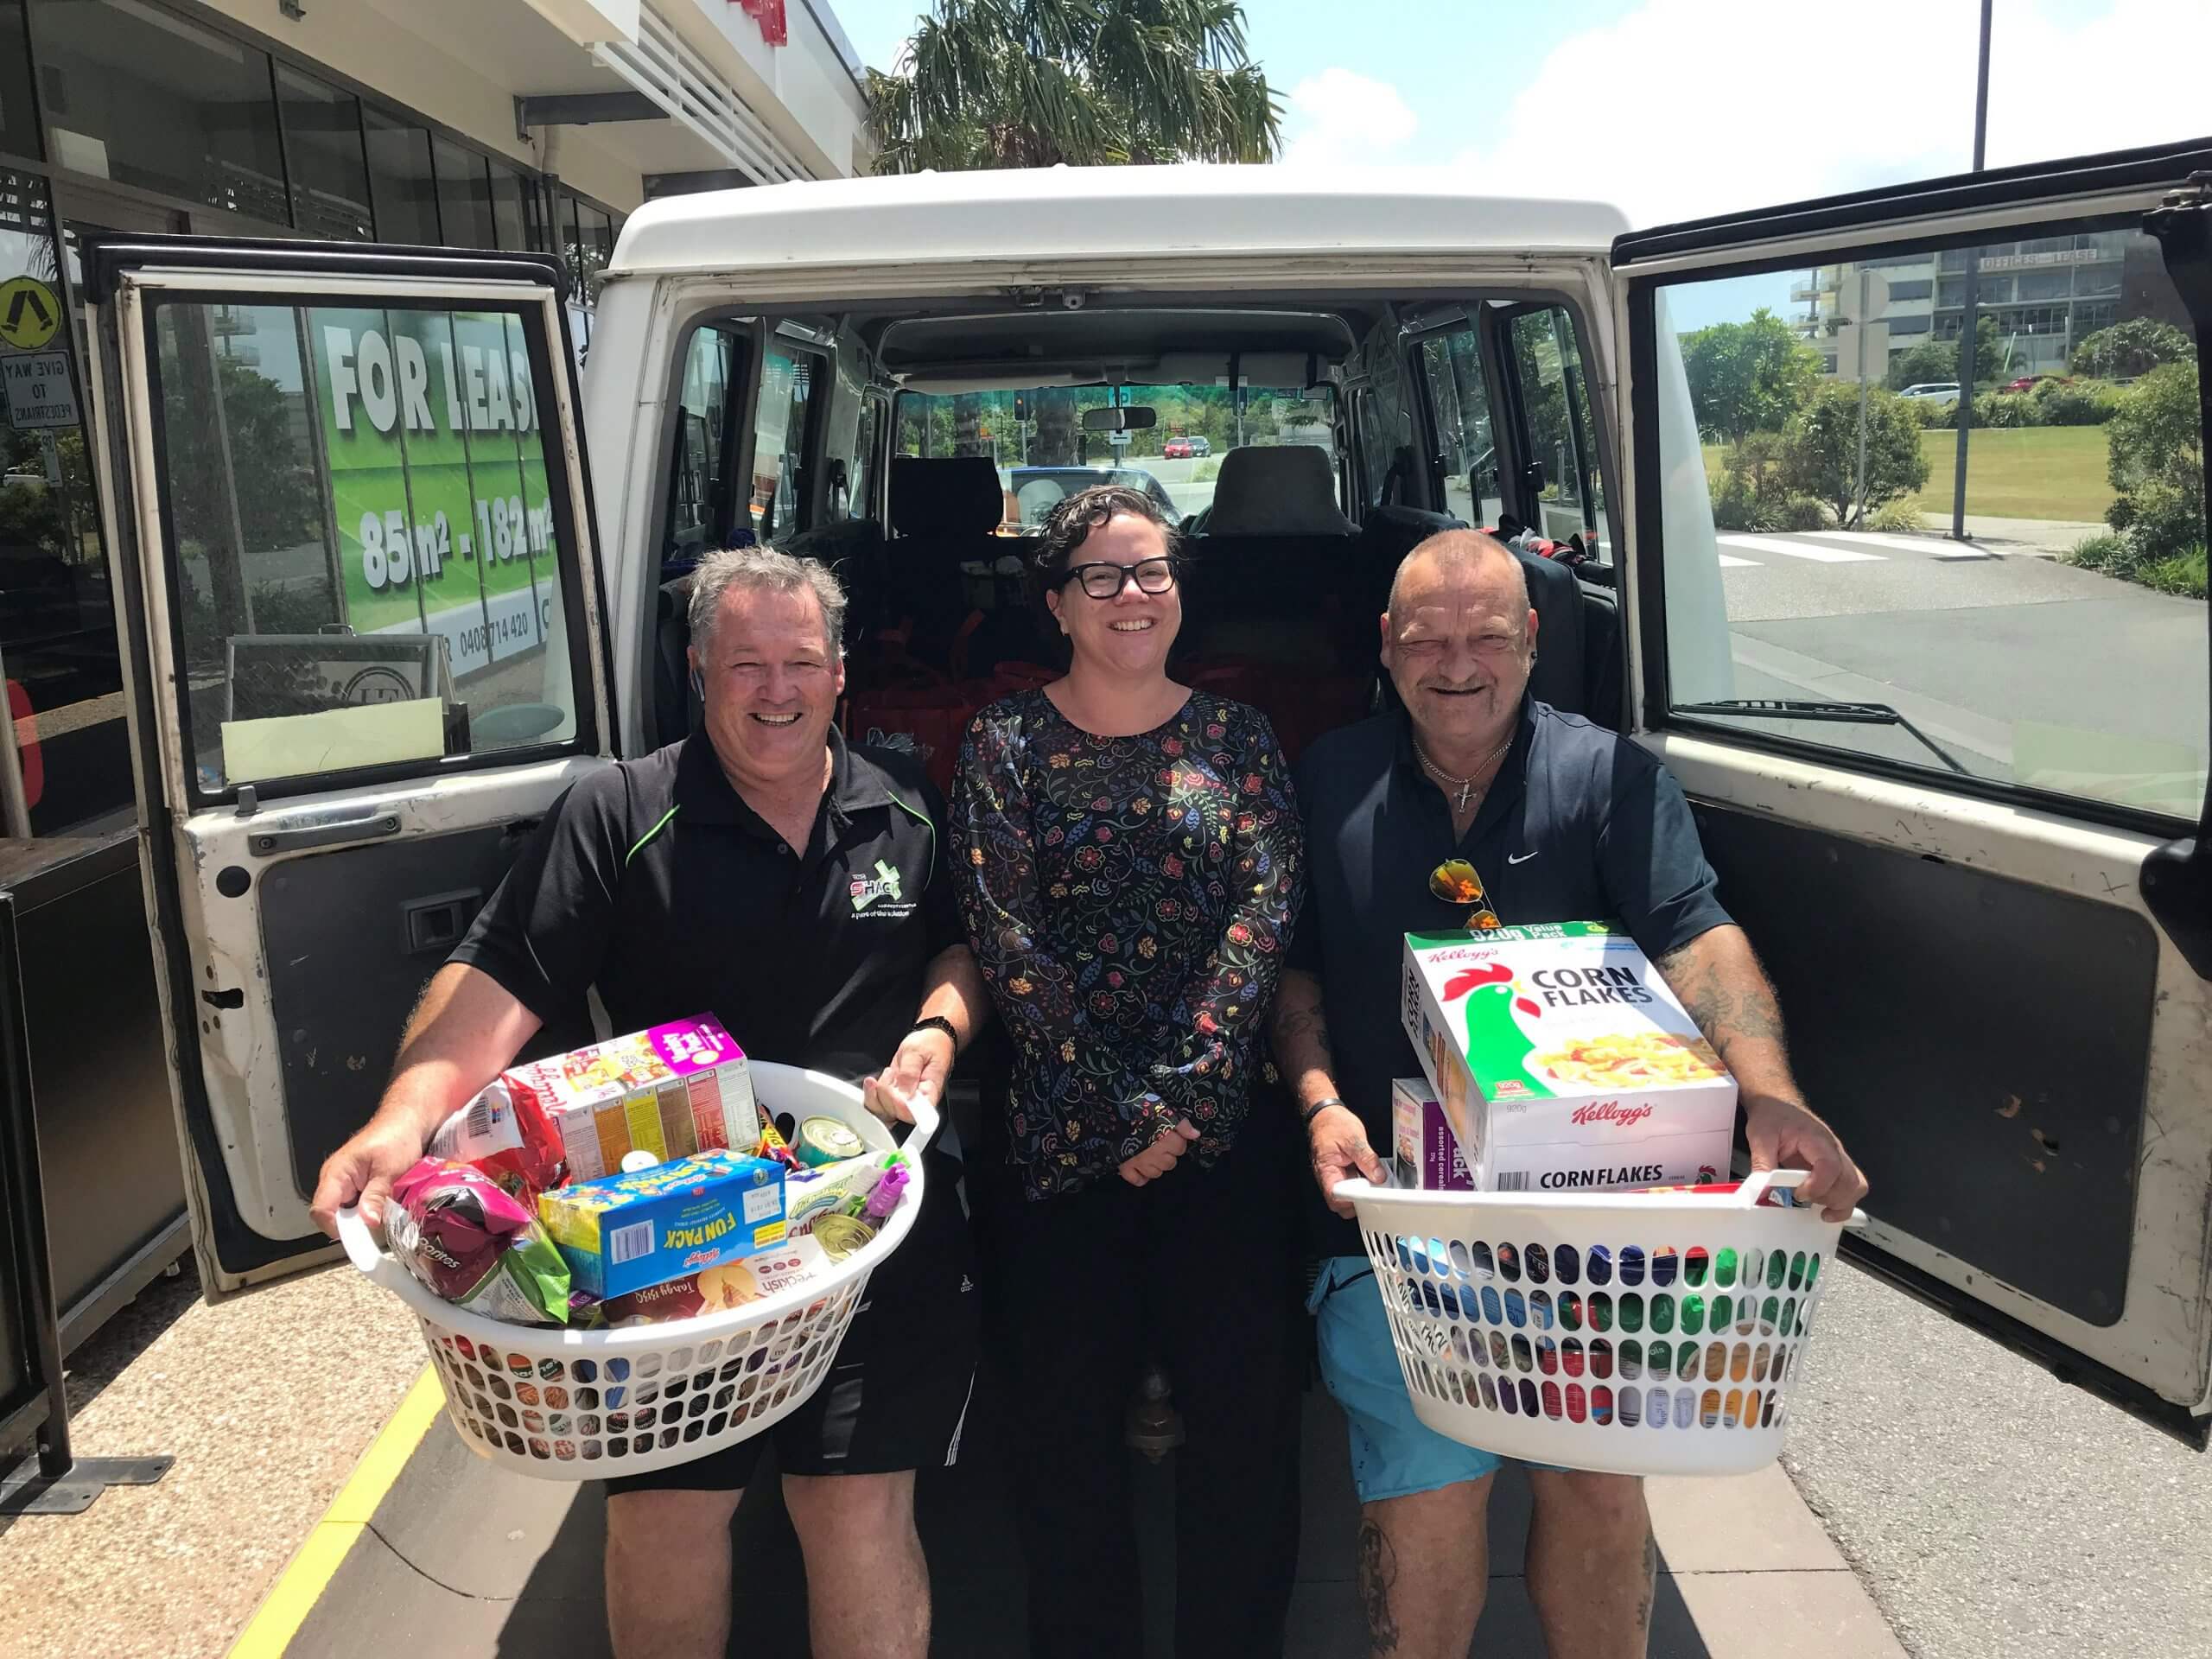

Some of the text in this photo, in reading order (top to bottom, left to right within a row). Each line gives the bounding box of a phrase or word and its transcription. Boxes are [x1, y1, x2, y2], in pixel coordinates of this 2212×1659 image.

[1983, 255, 2036, 270] OFFICES
[2052, 250, 2097, 264] LEASE
[324, 325, 540, 432] FOR LEAS
[461, 627, 486, 657] 0408
[489, 619, 508, 647] 714
[511, 612, 528, 638] 420
[1470, 924, 1563, 942] 920g Value
[1532, 930, 1568, 939] Pack
[1427, 948, 1500, 963] Kellogg's
[1531, 967, 1641, 989] CORN
[1541, 987, 1654, 1007] FLAKES
[1506, 1104, 1527, 1114] 920g
[1571, 1100, 1653, 1126] Kellogg's
[1540, 1165, 1663, 1189] CORN FLAKES
[664, 1227, 704, 1249] PACK
[704, 1211, 737, 1243] FUN
[418, 1236, 461, 1270] Doritos
[635, 1281, 696, 1304] Tangy BBQ
